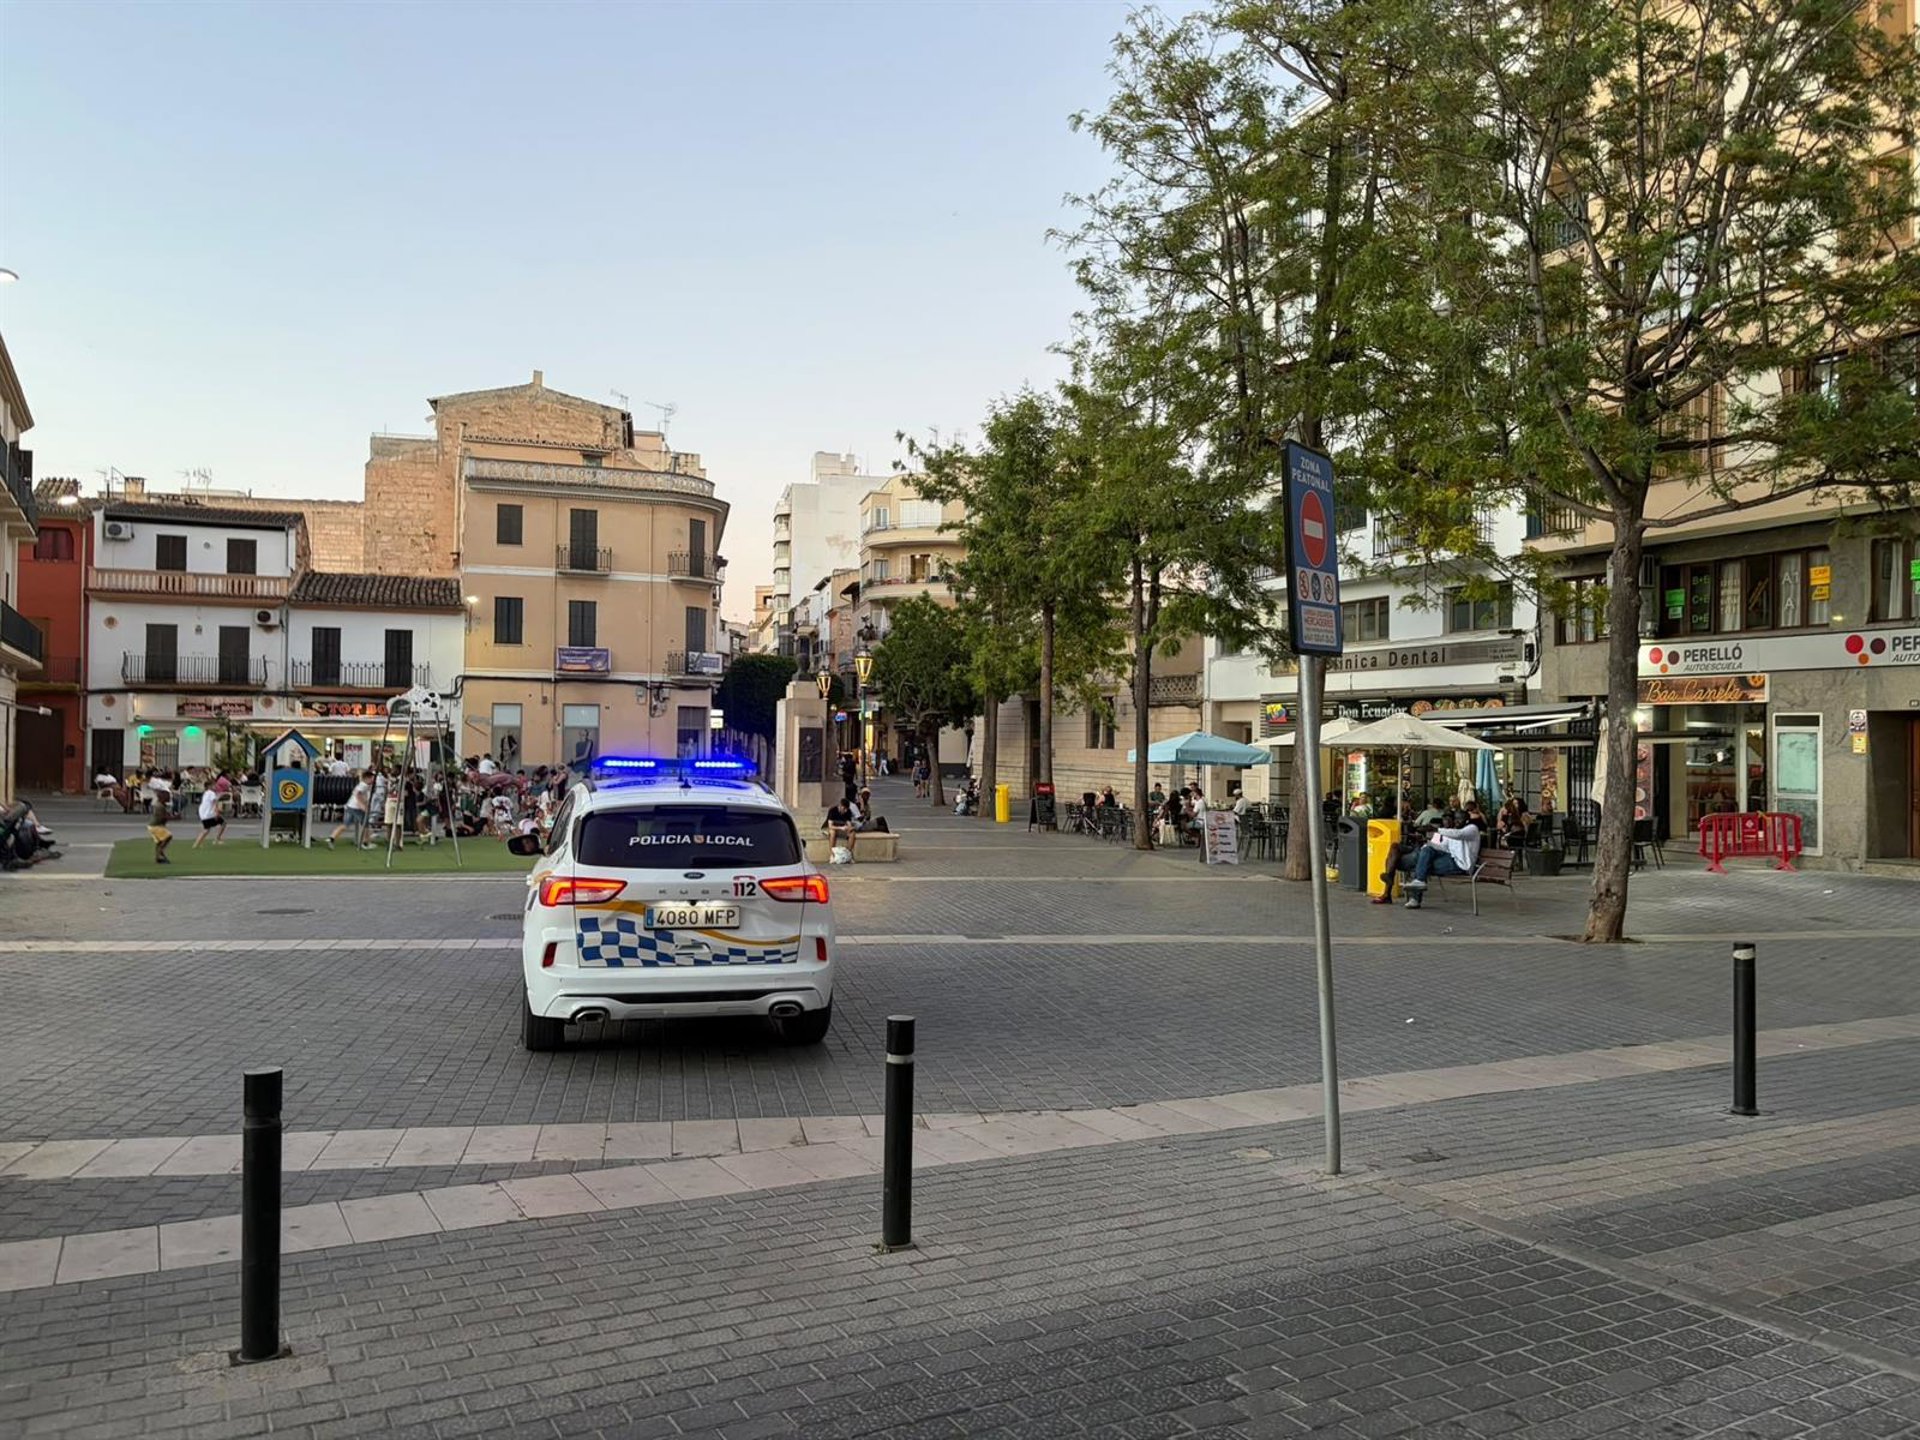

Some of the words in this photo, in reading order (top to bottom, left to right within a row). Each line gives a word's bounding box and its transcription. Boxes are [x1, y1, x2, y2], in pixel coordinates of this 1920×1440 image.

[1300, 456, 1321, 475] ZONA
[1291, 467, 1330, 493] PEATONAL
[1389, 647, 1446, 667] Dental
[1684, 643, 1742, 662] PERELLÓ
[1683, 661, 1742, 672] AUTOESCUELA
[327, 703, 362, 716] TOT
[1338, 704, 1359, 719] Don
[1361, 703, 1408, 719] Ecuador
[629, 834, 691, 846] POLICIA
[706, 835, 754, 847] LOCAL
[732, 882, 756, 897] 112
[656, 909, 699, 926] 4080
[704, 909, 736, 925] MFP
